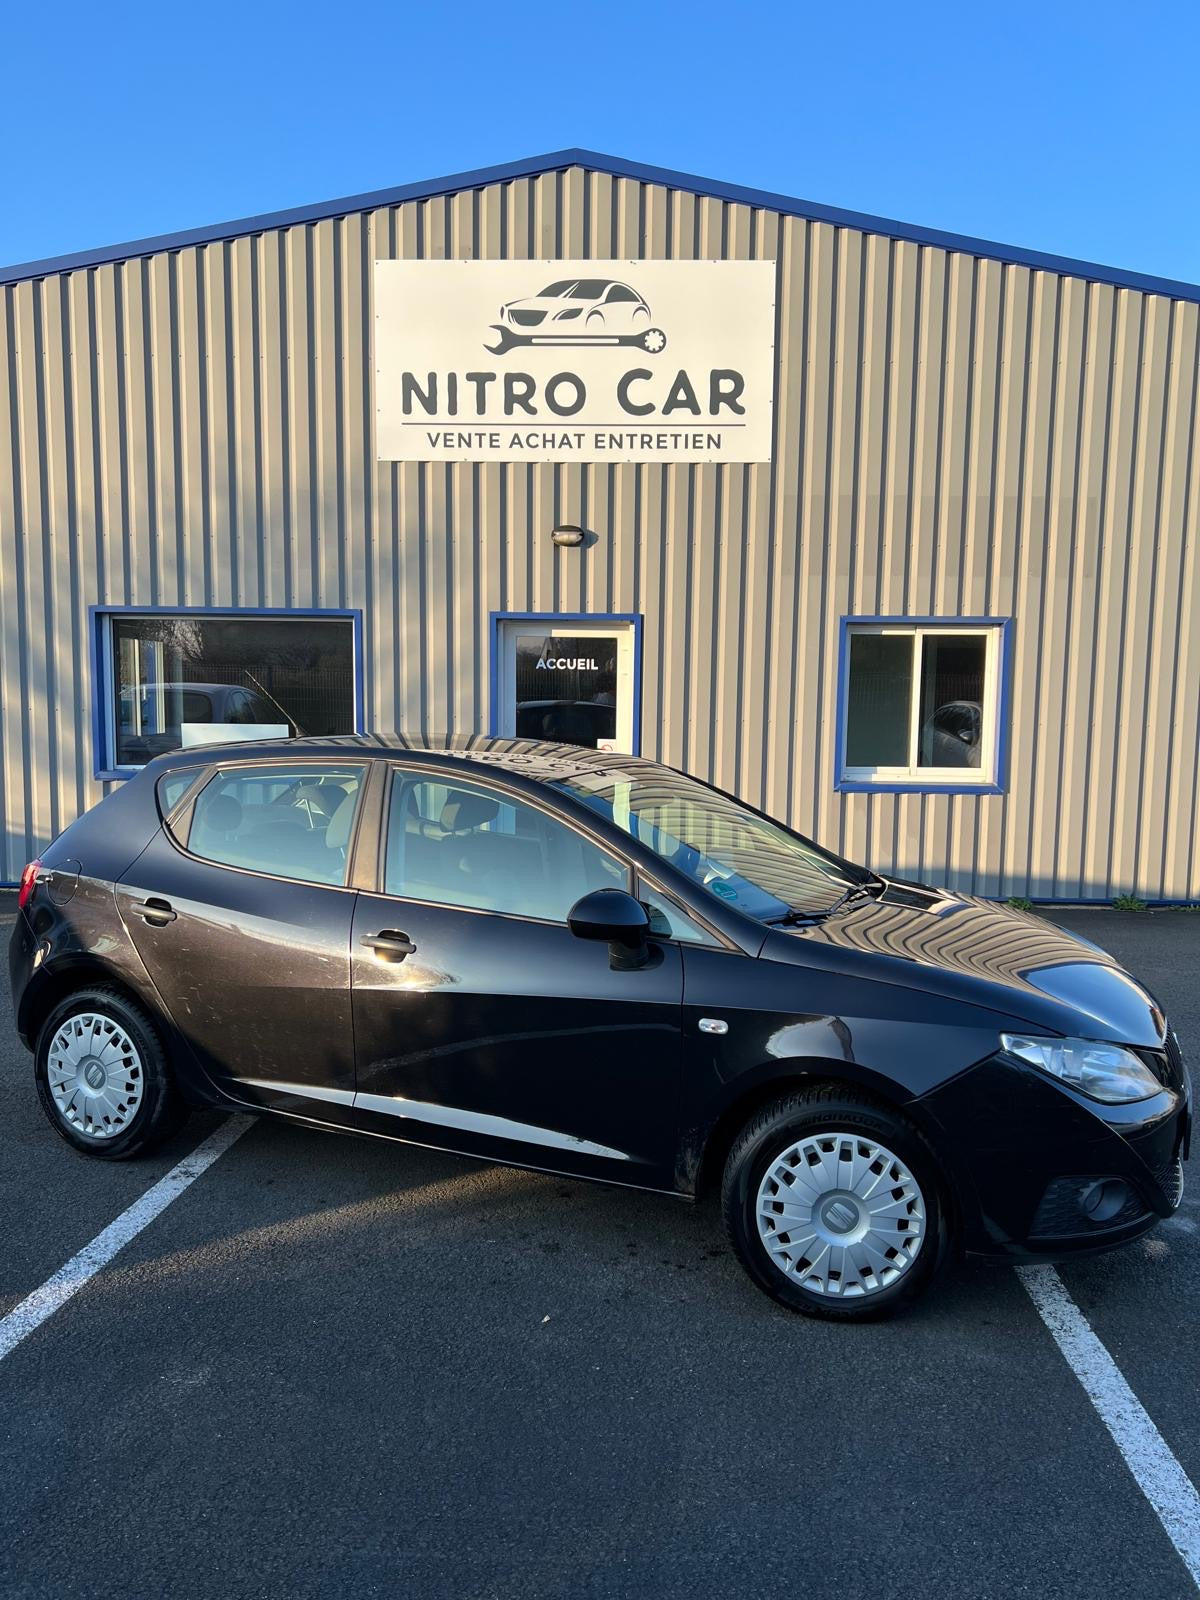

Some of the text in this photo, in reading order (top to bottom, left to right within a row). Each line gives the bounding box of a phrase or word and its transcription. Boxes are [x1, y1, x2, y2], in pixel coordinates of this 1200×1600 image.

[402, 368, 745, 416] NITRO CAR
[427, 433, 722, 449] VENTE ACHAT ENTRETIEN
[536, 658, 598, 670] ACCUEIL
